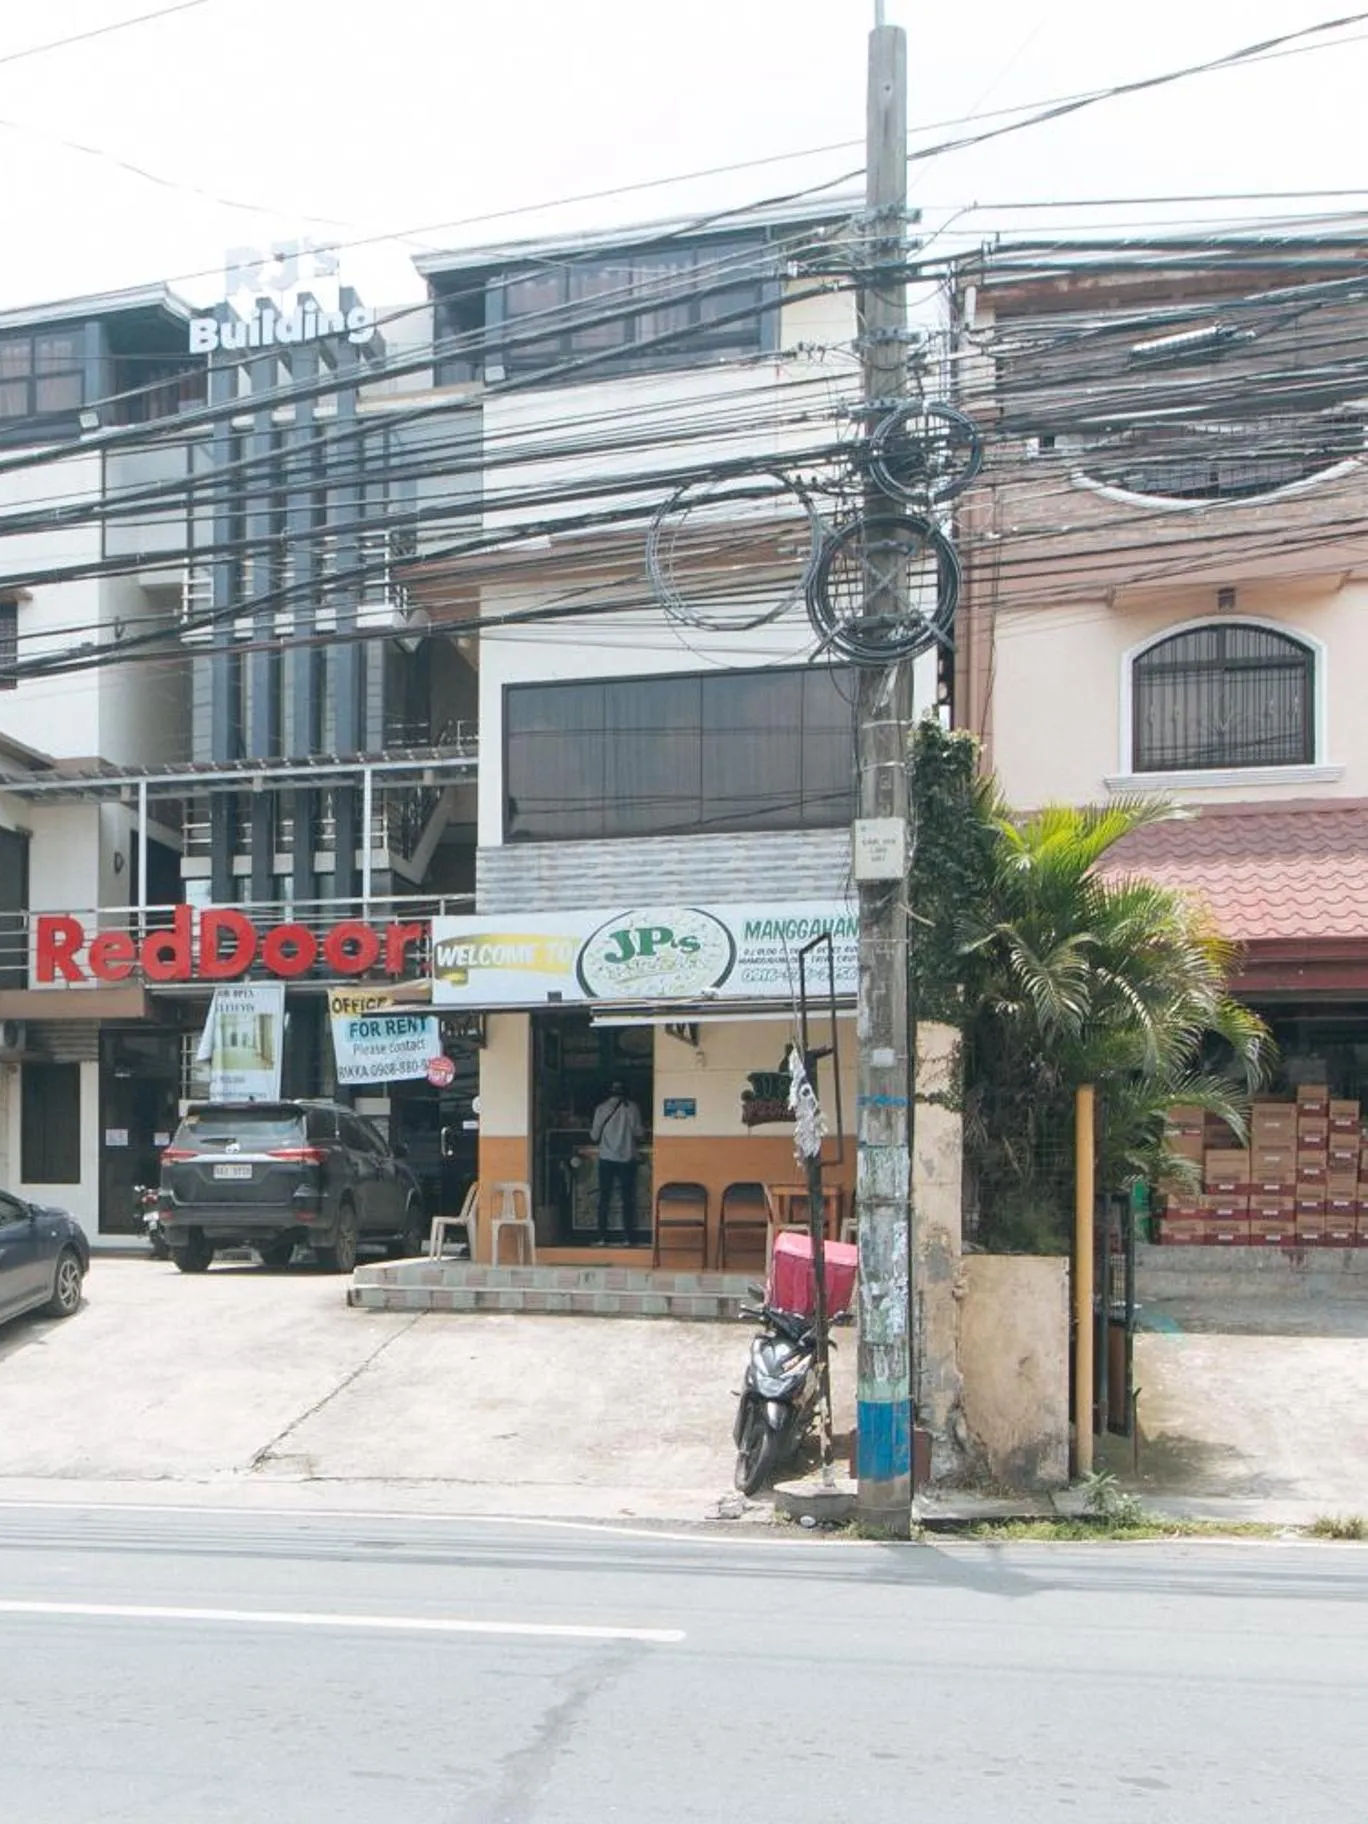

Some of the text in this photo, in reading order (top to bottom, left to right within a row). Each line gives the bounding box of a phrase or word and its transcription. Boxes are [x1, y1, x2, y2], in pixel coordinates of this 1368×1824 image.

[189, 300, 375, 354] Building
[744, 916, 859, 941] MANGGAHAN
[36, 905, 432, 984] RedDoor
[437, 943, 534, 968] WELCOME
[350, 1021, 381, 1038] FOR
[385, 1016, 427, 1035] RENT
